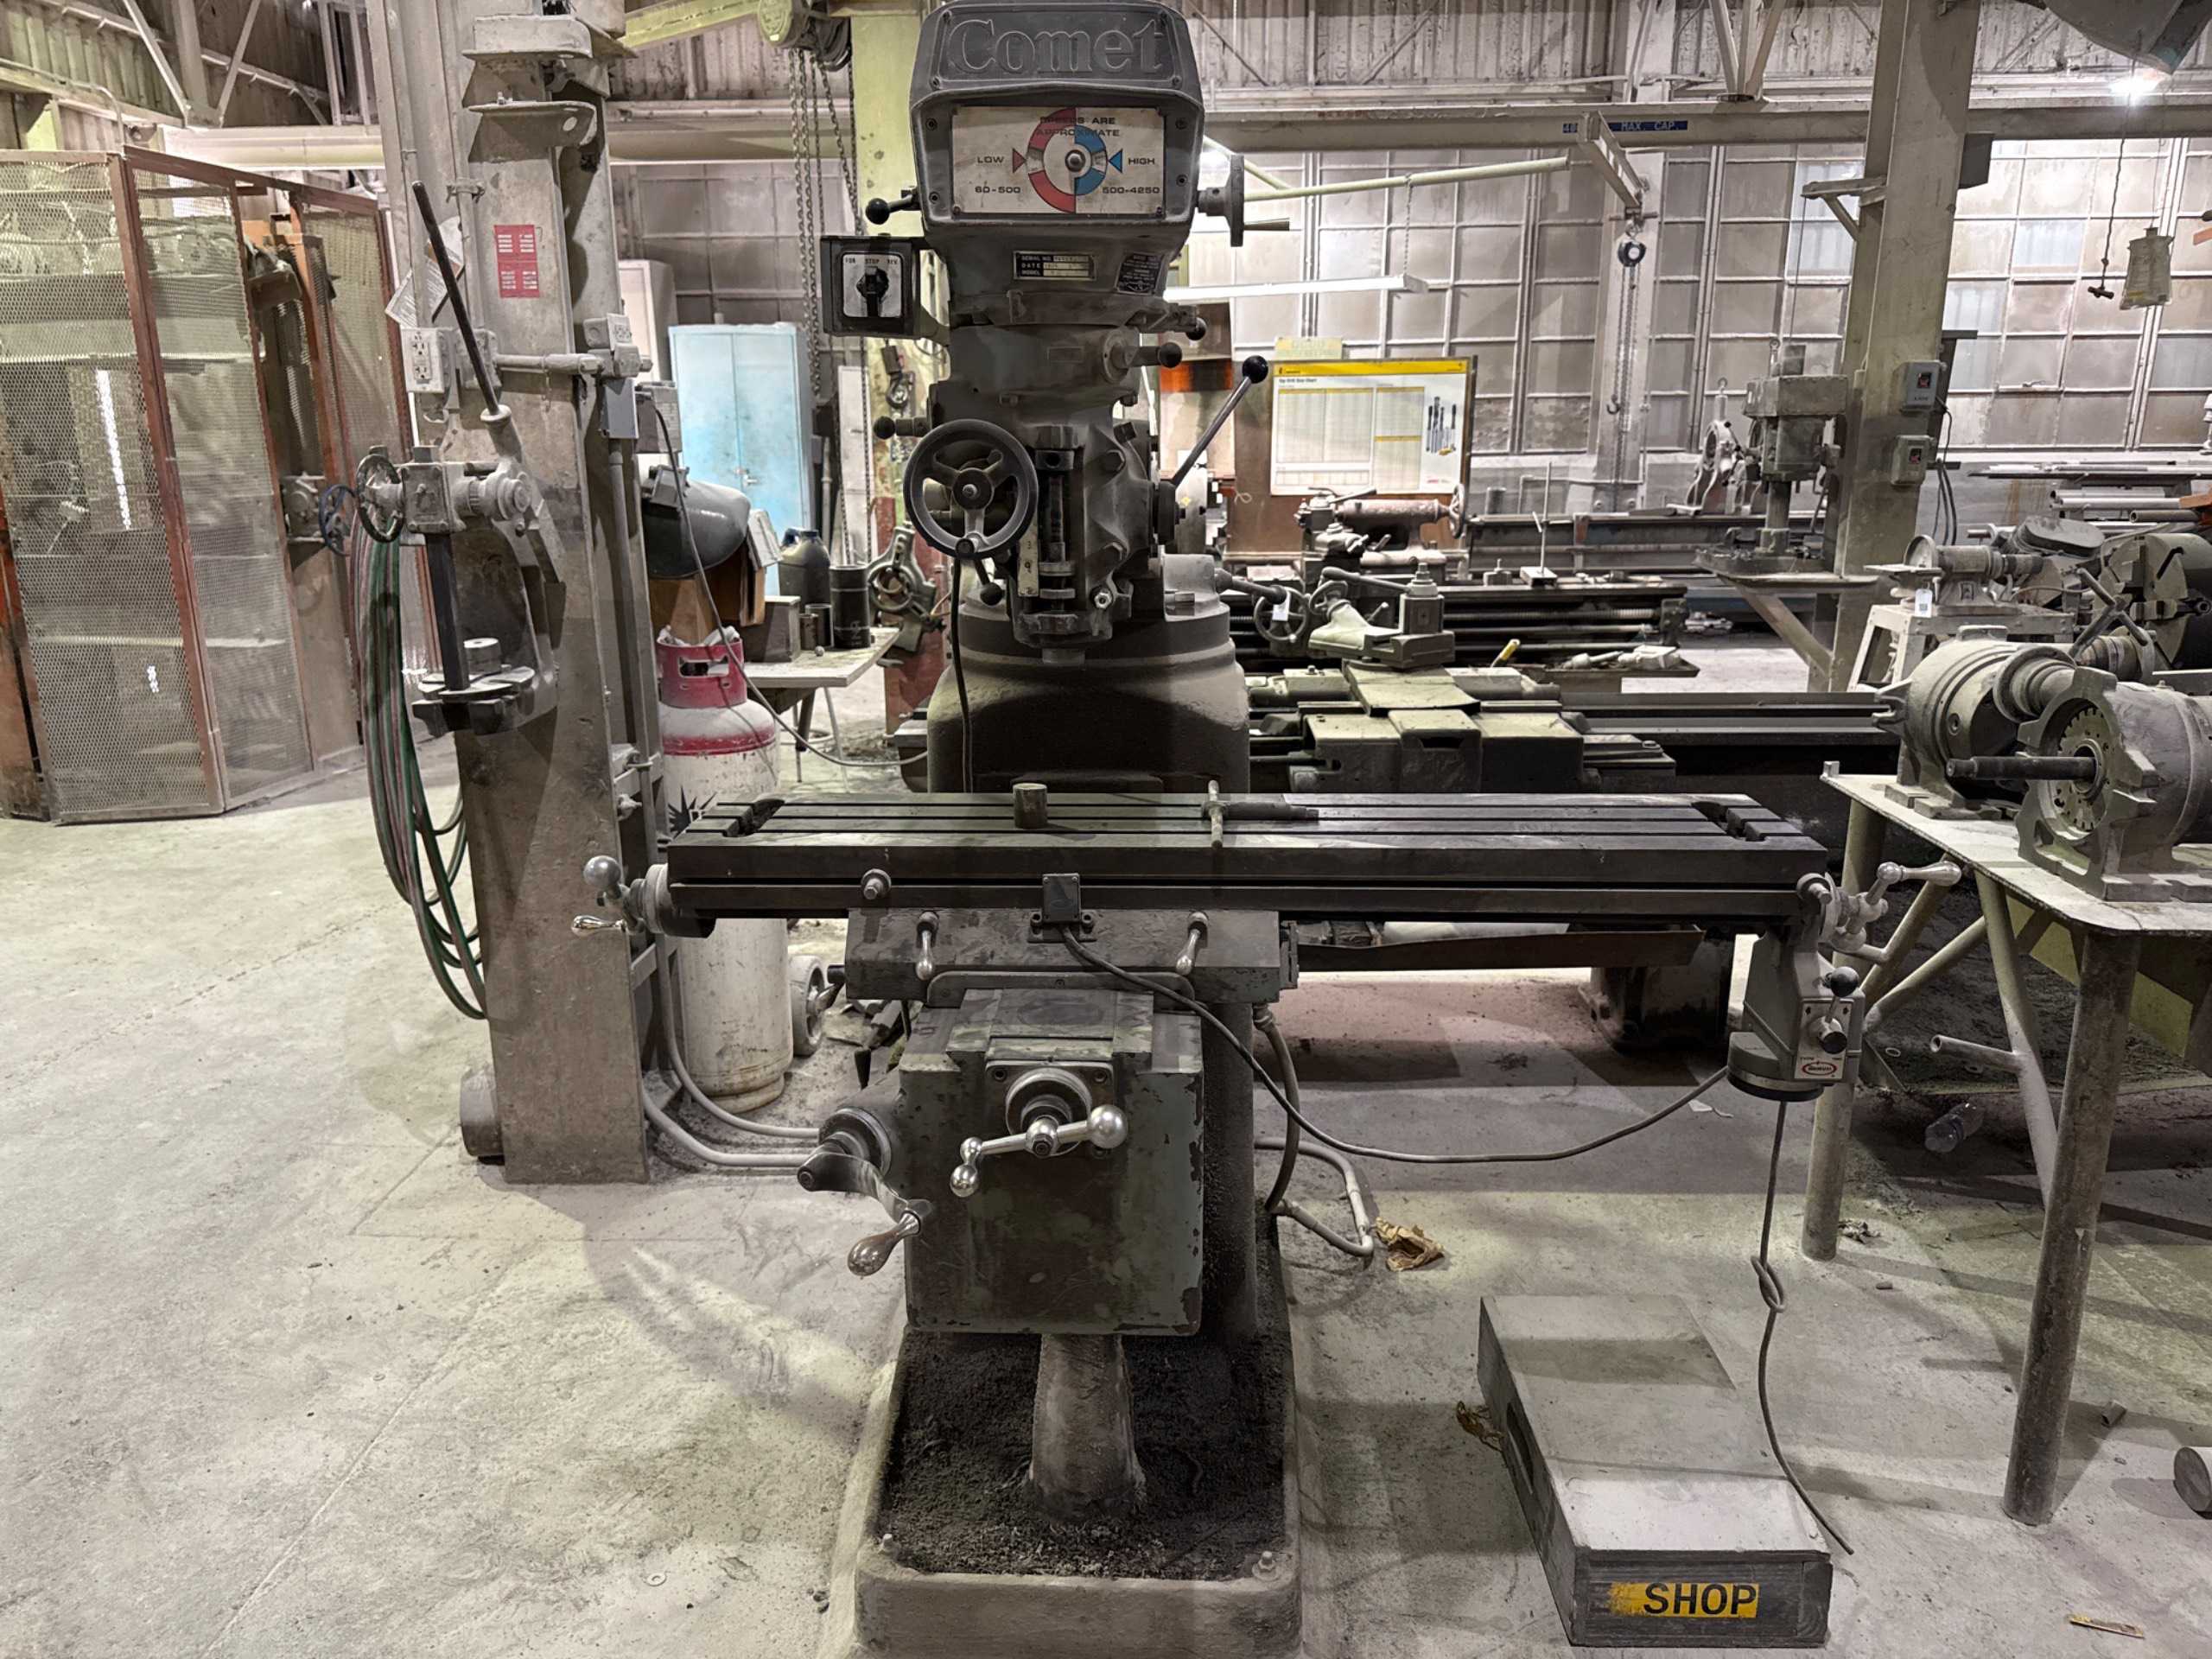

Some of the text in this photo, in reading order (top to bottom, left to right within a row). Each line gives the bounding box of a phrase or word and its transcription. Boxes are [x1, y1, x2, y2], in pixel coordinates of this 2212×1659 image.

[947, 19, 1164, 74] Comet
[1039, 117, 1116, 125] SPEEDS ARE
[1654, 120, 1680, 131] CAP.
[1036, 129, 1121, 137] APPROXIMATE
[975, 186, 1021, 194] 60-500
[1102, 186, 1160, 194] 500-4250
[1643, 1582, 1757, 1615] SHOP
